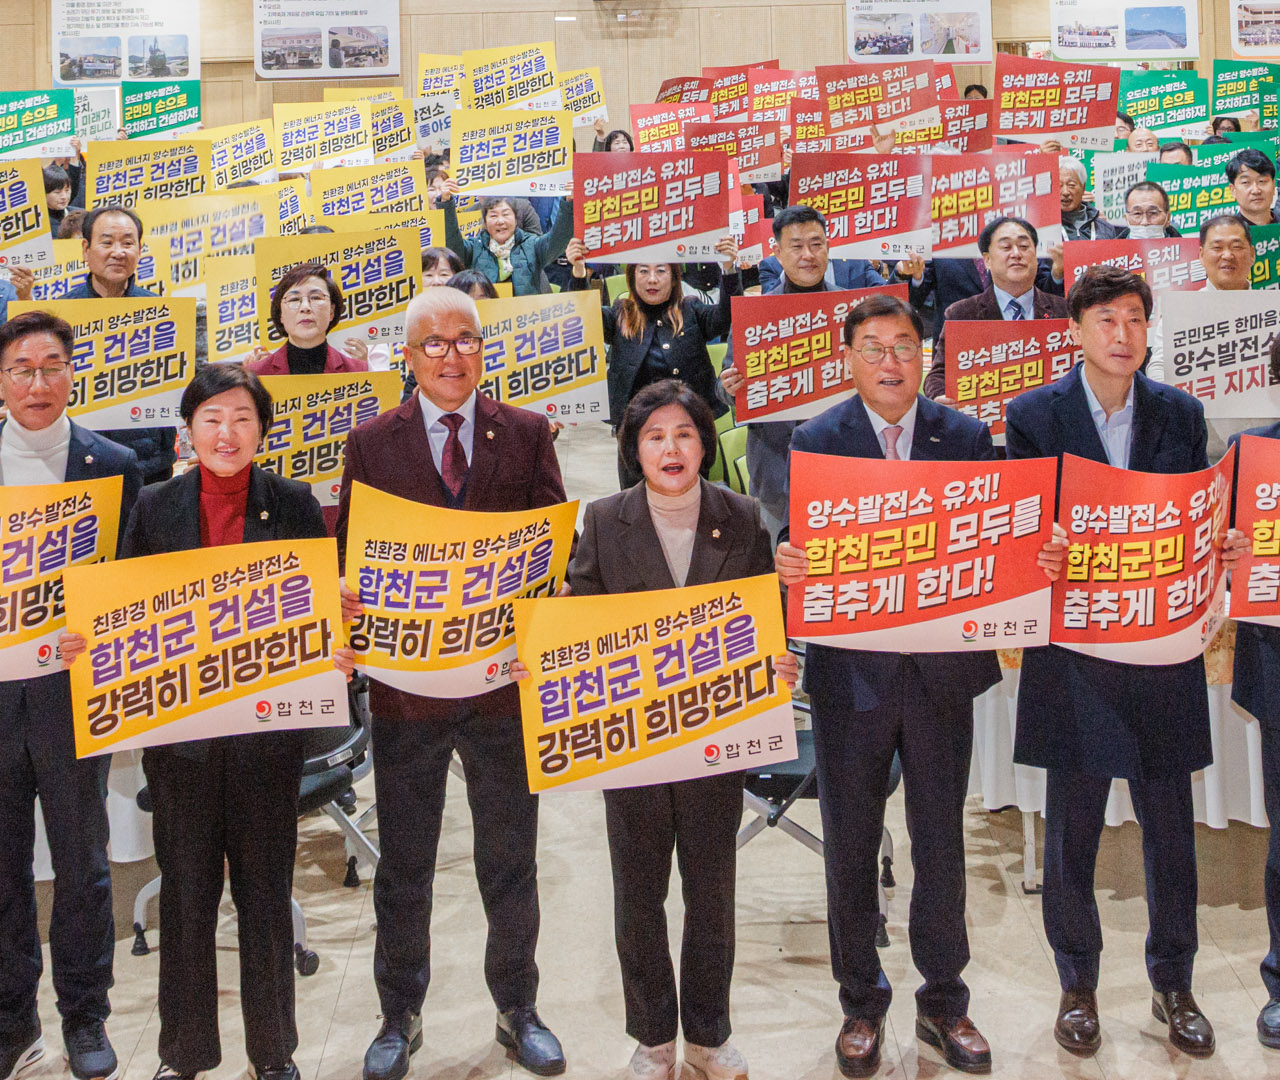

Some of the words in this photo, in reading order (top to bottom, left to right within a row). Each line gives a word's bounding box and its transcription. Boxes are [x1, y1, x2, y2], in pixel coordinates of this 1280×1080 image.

[584, 167, 656, 196] 양수발전소
[661, 158, 694, 180] 유치!
[584, 186, 658, 224] 합천군민
[665, 172, 720, 205] 모두를
[584, 217, 642, 250] 춤추게
[649, 206, 694, 237] 한다!
[805, 522, 937, 576] 합천군민
[947, 494, 1041, 554] 모두를
[807, 488, 933, 529] 양수발전소
[942, 472, 1000, 510] 유치!
[93, 599, 146, 637] 친환경
[153, 579, 205, 612] 에너지
[212, 551, 300, 593] 양수발전소
[803, 574, 905, 622] 춤추게
[917, 555, 995, 608] 한다!
[90, 610, 196, 685] 합천군
[209, 574, 312, 641] 건설을
[539, 655, 641, 723] 합천군
[653, 614, 756, 687] 건설을
[541, 641, 590, 672] 친환경
[597, 623, 648, 656] 에너지
[655, 592, 743, 637] 양수발전소
[87, 663, 188, 736] 강력히
[198, 618, 332, 696] 희망한다
[538, 709, 636, 774] 강력히
[645, 655, 777, 742] 희망한다
